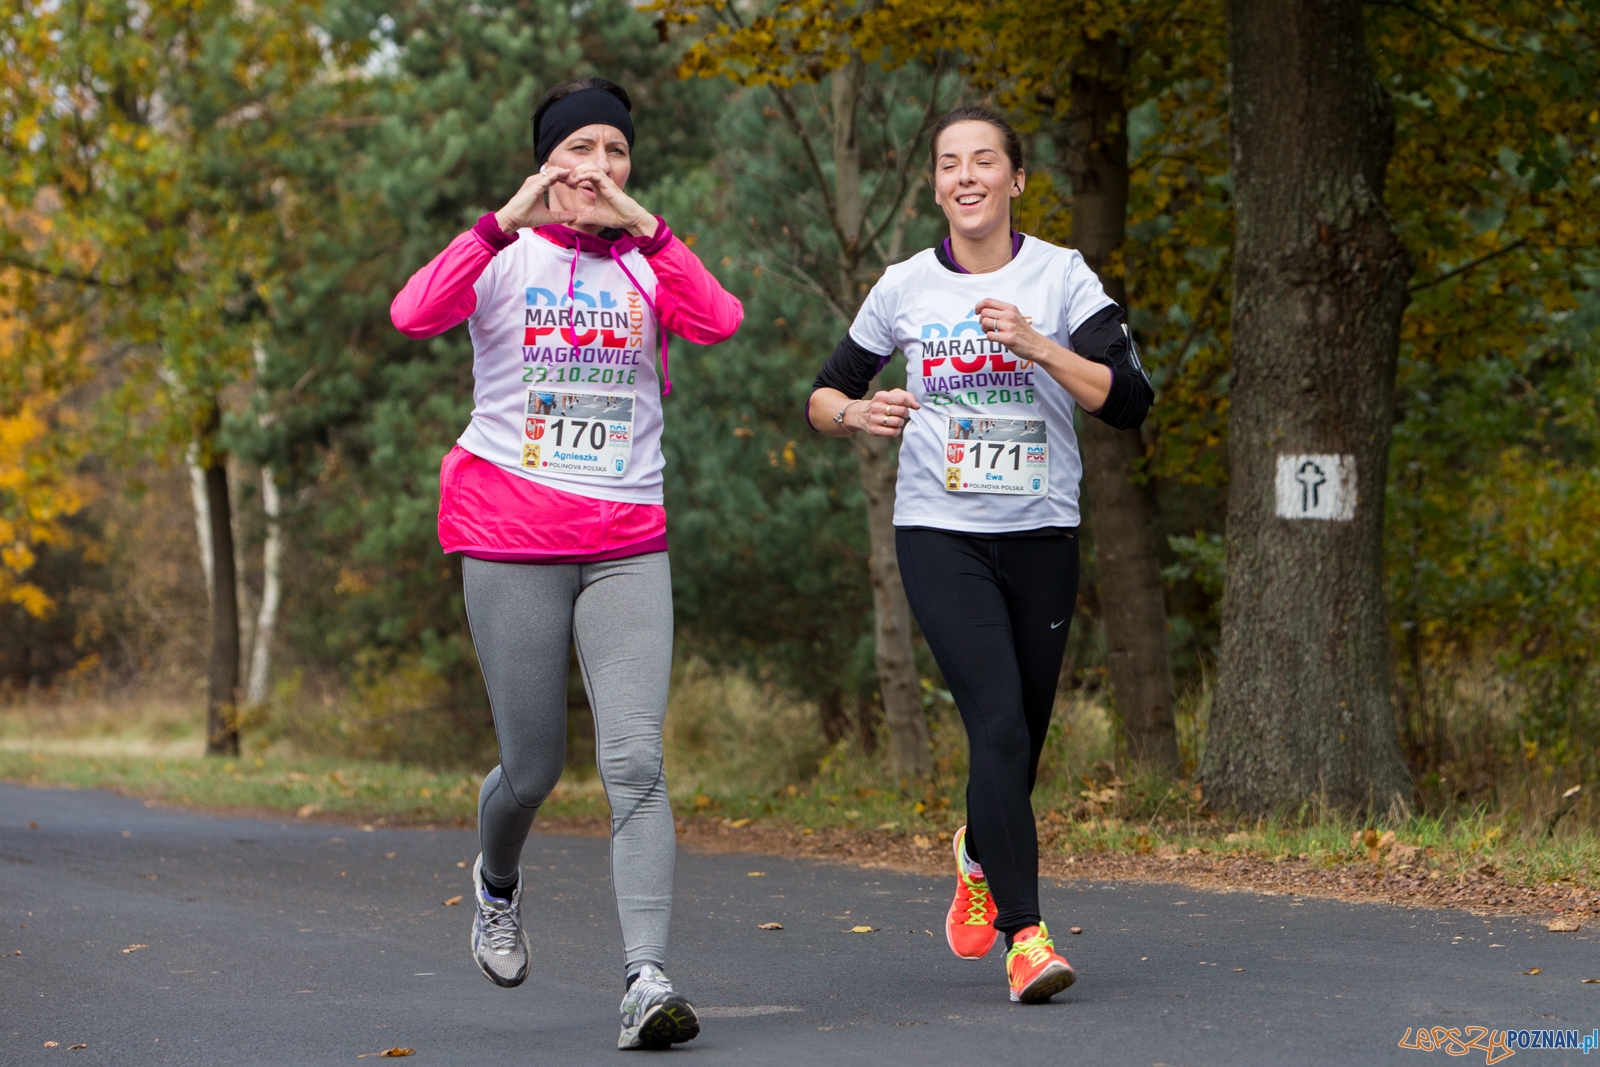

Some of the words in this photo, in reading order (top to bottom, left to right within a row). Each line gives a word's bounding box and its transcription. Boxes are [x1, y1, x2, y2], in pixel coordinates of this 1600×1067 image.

[525, 309, 629, 329] MARATON
[627, 291, 643, 348] SKOKI
[522, 347, 641, 366] WĄGROWIEC
[922, 338, 1009, 358] MARATO
[522, 367, 637, 385] 23.10.2016
[922, 372, 1035, 394] WĄGROWIEC
[928, 389, 1035, 407] 23.10.2016
[551, 419, 607, 450] 170
[549, 462, 582, 470] POLINOVA
[553, 451, 598, 462] Agnieszka
[969, 442, 1021, 471] 171
[985, 472, 1003, 481] Ewa
